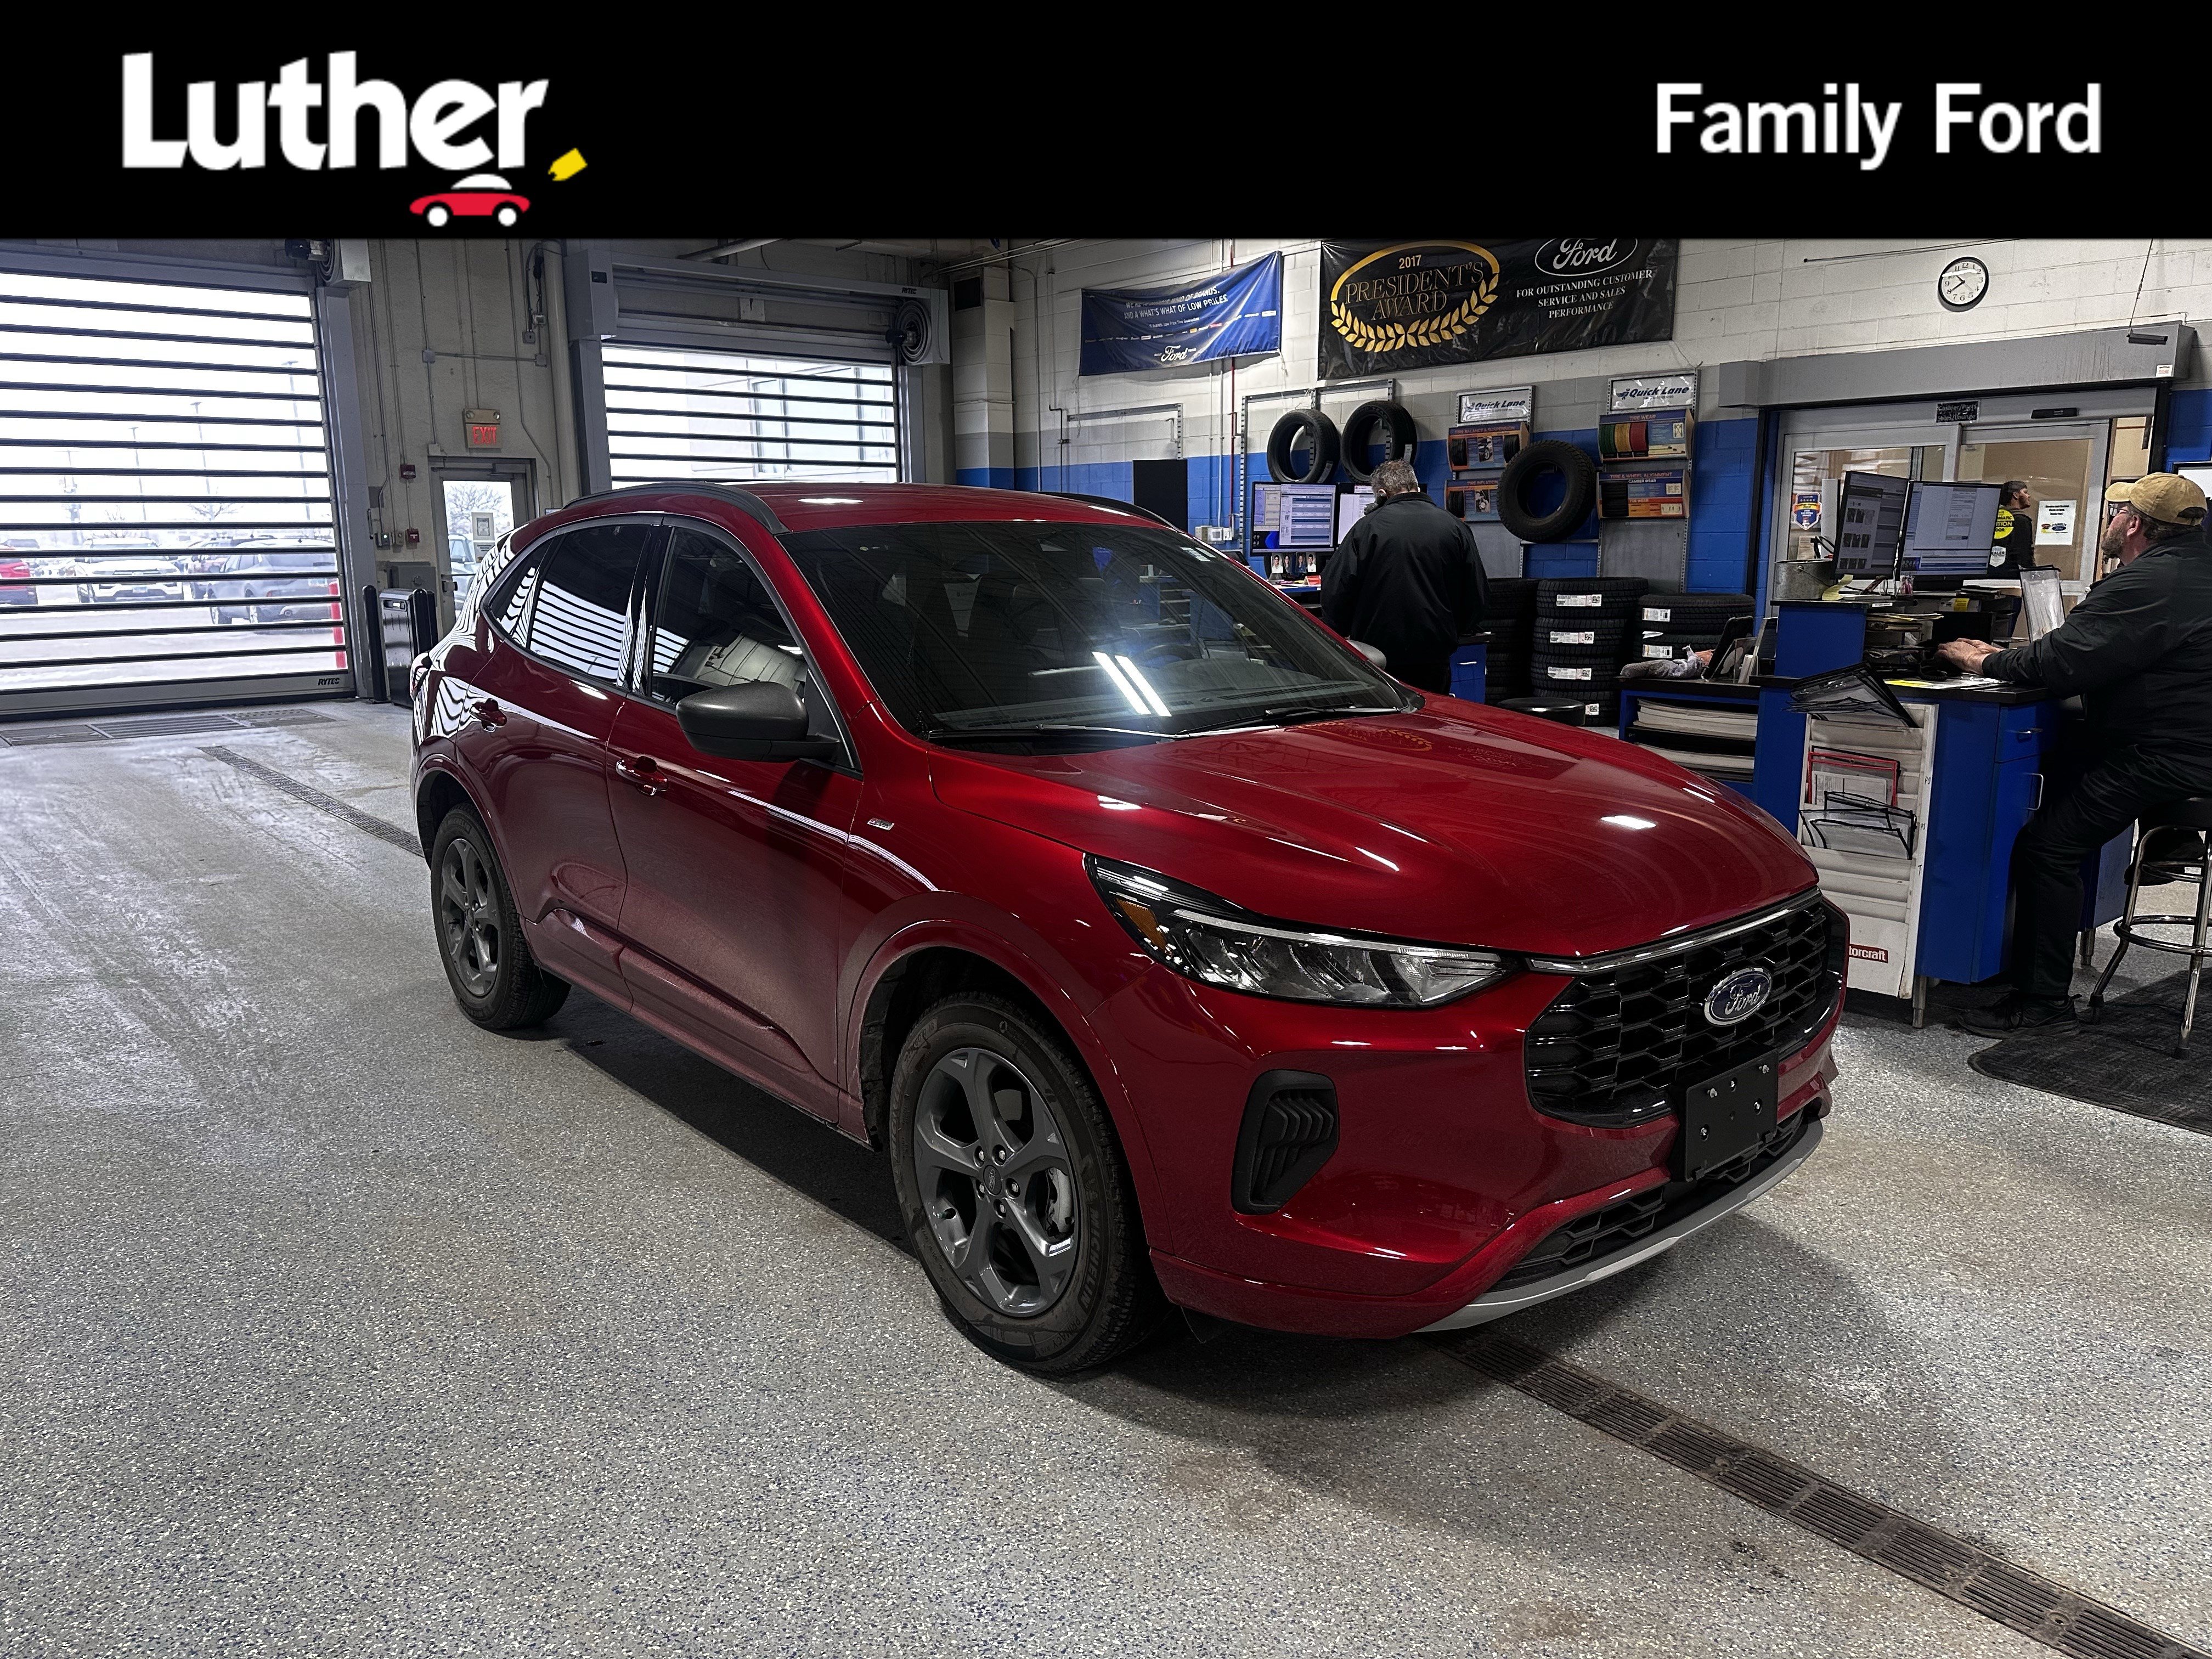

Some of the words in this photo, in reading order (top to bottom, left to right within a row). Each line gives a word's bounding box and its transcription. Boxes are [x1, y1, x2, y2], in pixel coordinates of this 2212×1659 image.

[1398, 255, 1422, 269] 2017
[1553, 238, 1617, 269] Ford
[1345, 262, 1484, 304] PRESIDENT'S
[1516, 288, 1534, 298] FOR
[1537, 278, 1600, 295] OUTSTANDING
[1602, 269, 1653, 286] CUSTOMER
[1371, 290, 1447, 321] AWARD
[1538, 294, 1577, 307] SERVICE
[1579, 292, 1598, 302] AND
[1600, 286, 1626, 298] SALES
[1124, 311, 1134, 319] AND
[1135, 311, 1139, 319] A
[1139, 308, 1159, 318] WHAT'S
[1160, 305, 1176, 315] WHAT
[1177, 303, 1186, 312] OF
[1187, 301, 1202, 311] LOW
[1548, 301, 1614, 319] PERFORMANCE
[1161, 345, 1189, 362] Ford
[1629, 387, 1660, 397] Quick
[1660, 386, 1689, 395] Lane
[1475, 401, 1501, 410] Quick
[1501, 400, 1526, 408] Lane
[473, 426, 497, 444] EXIT
[1849, 945, 1887, 961] torcraft
[1725, 980, 1762, 1015] Ford
[1080, 1207, 1100, 1309] MICHELIN
[1052, 1316, 1081, 1348] PRIMACY
